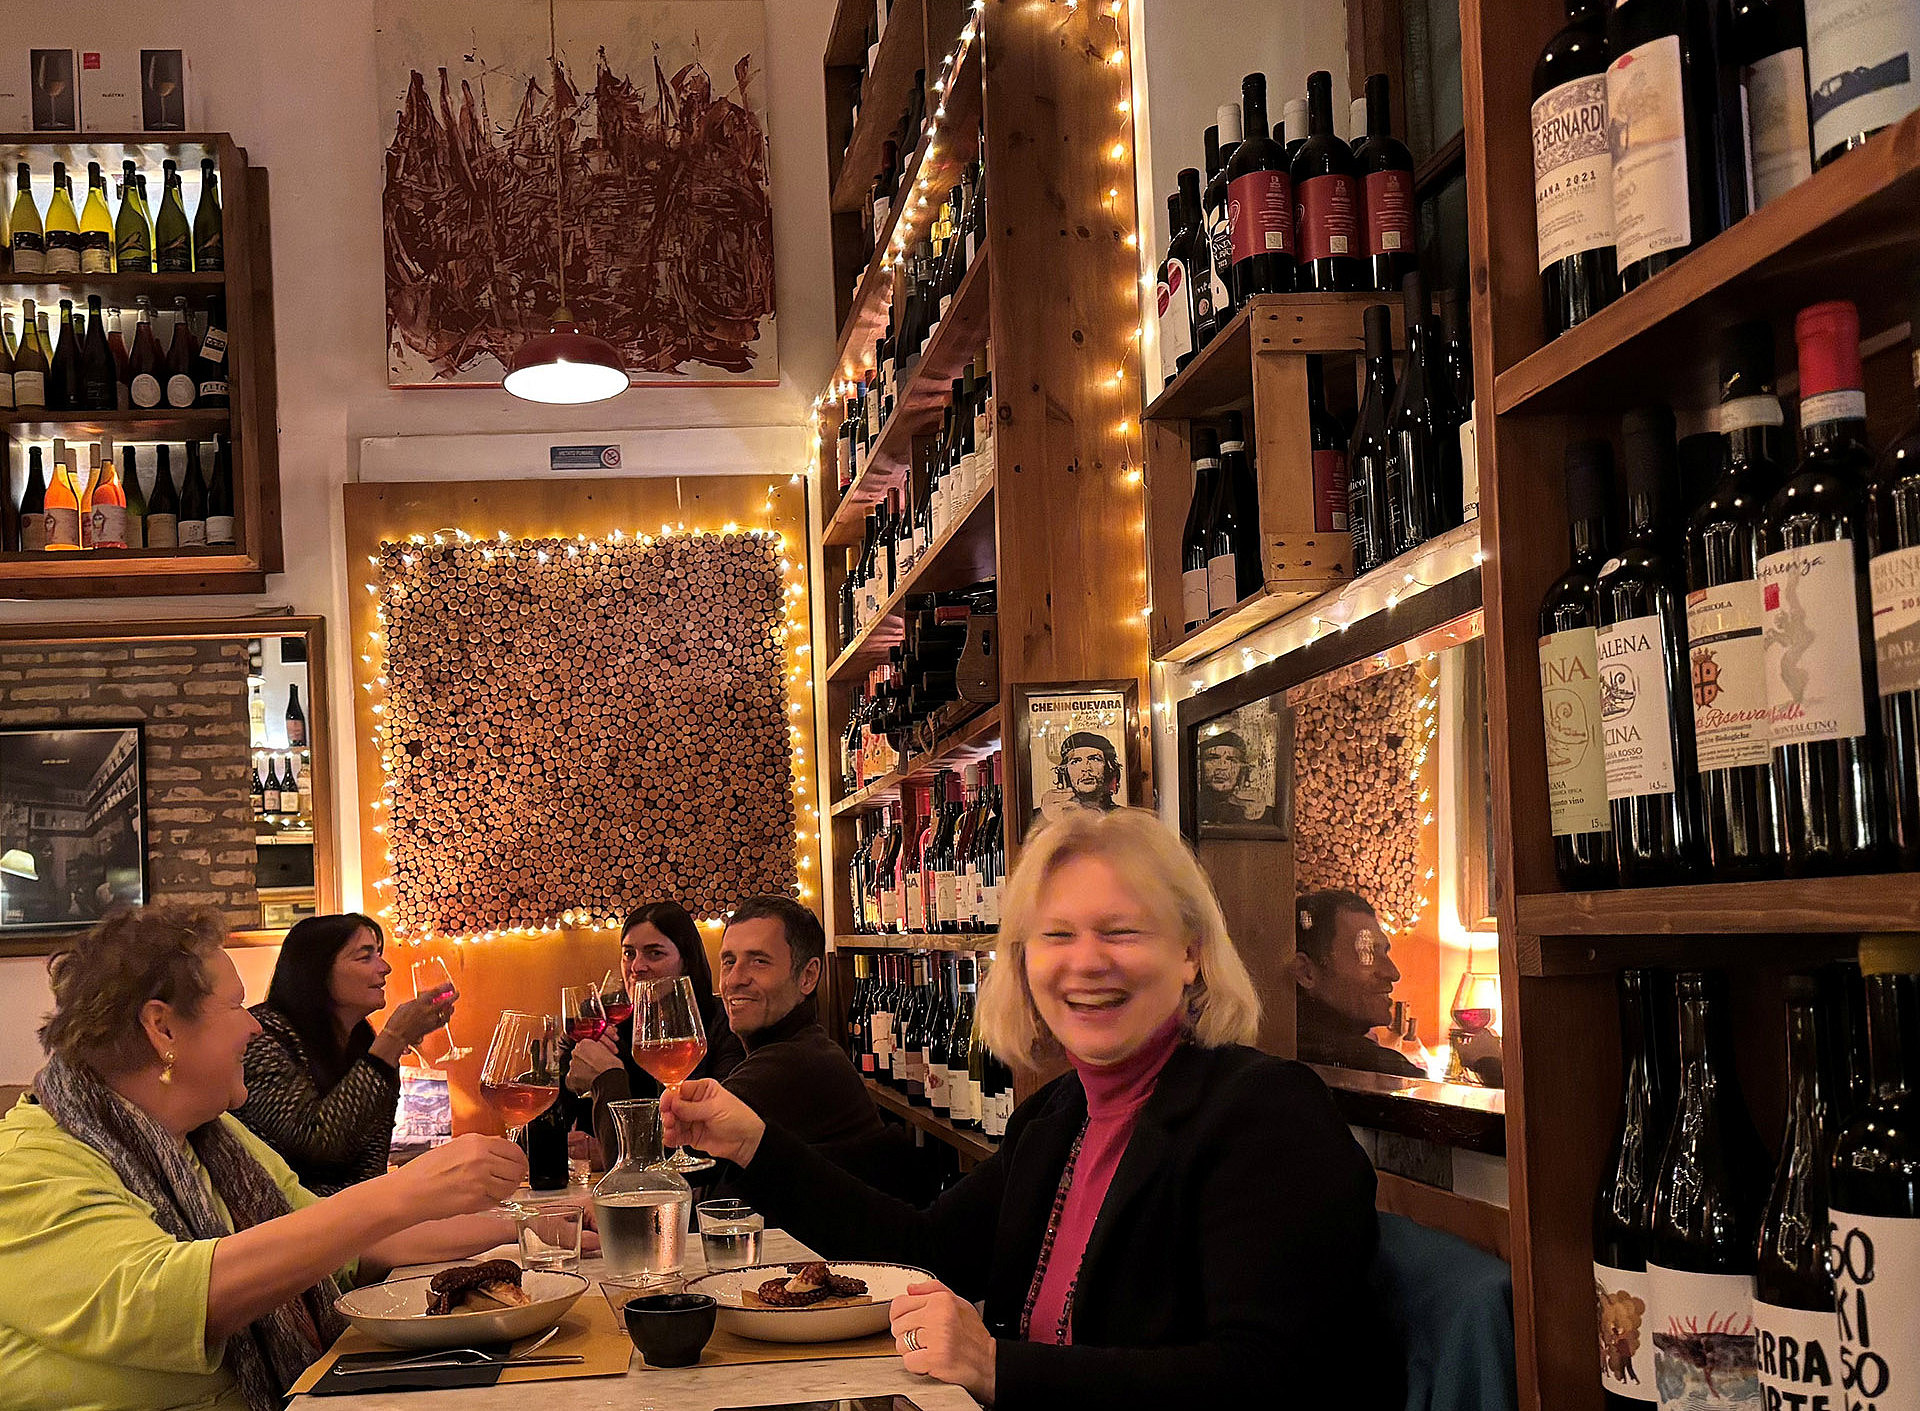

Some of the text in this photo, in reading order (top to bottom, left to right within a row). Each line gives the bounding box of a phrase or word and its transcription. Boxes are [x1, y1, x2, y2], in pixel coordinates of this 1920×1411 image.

[1566, 169, 1597, 187] 2021
[1598, 633, 1652, 661] ALENA
[1031, 699, 1122, 713] CHENINGUEVARA
[1705, 708, 1767, 729] Riserva
[1568, 796, 1585, 805] vino
